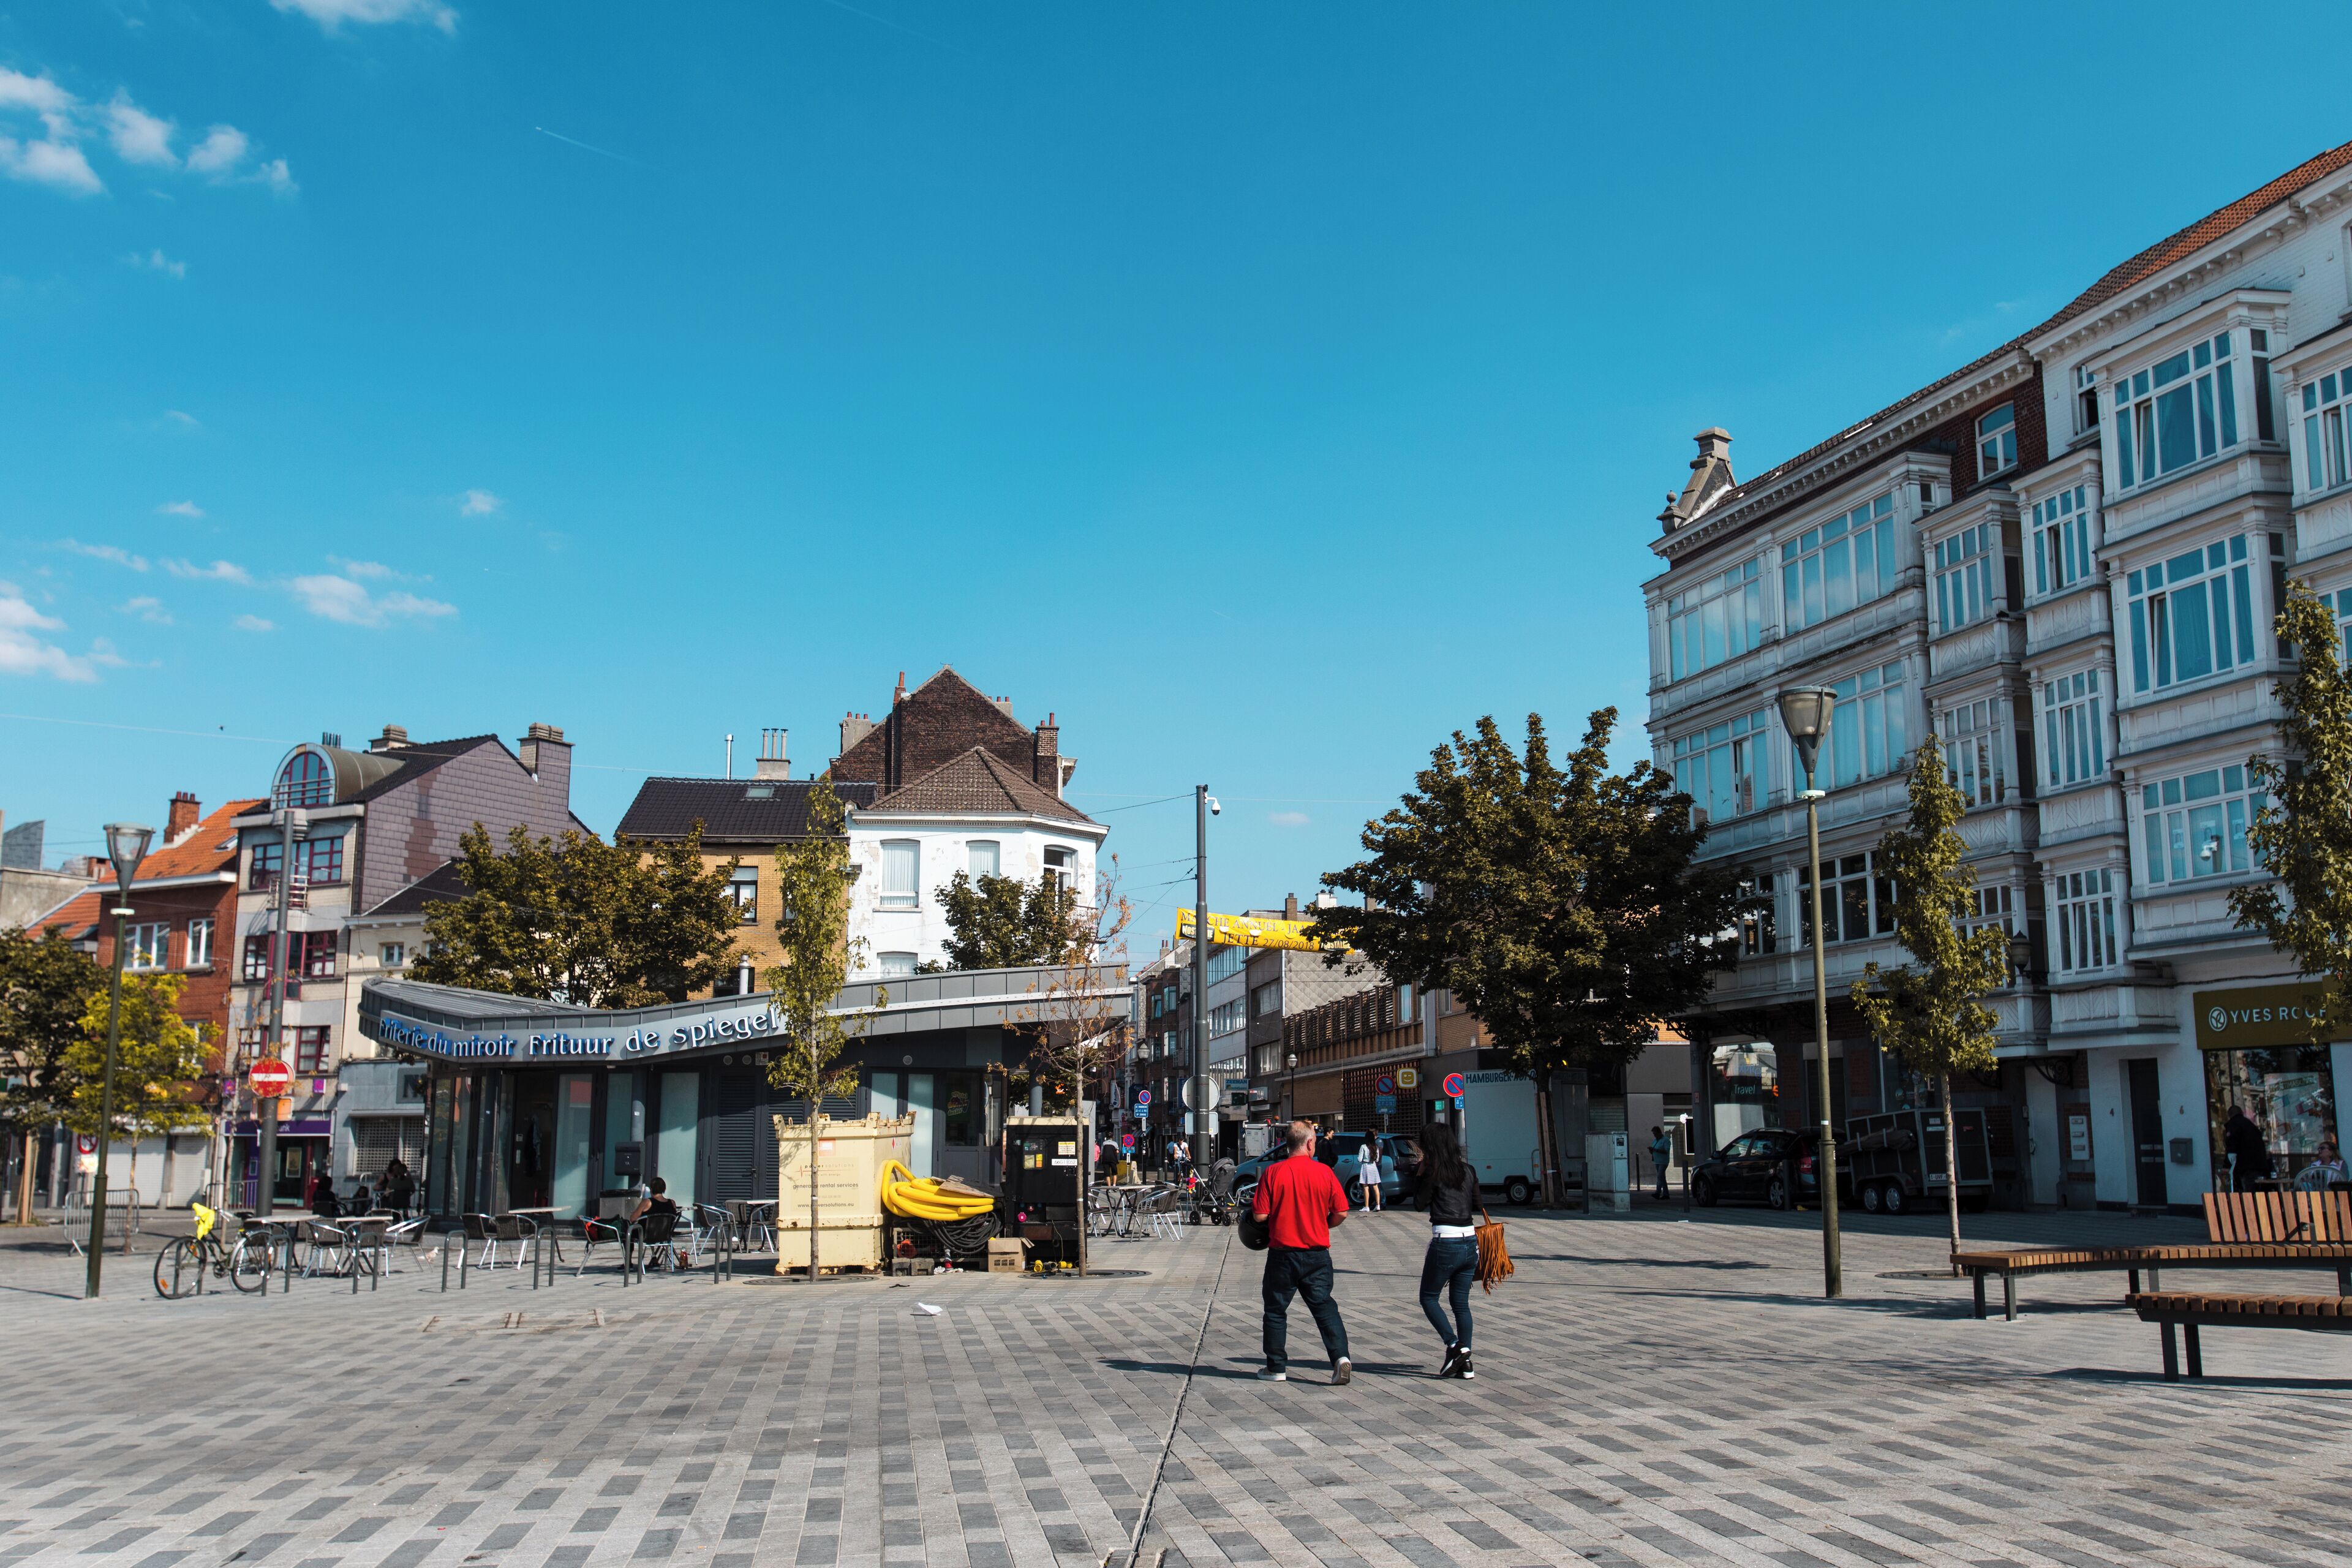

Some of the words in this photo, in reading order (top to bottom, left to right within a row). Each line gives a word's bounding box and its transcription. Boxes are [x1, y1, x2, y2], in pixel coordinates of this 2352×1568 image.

[1181, 912, 1229, 927] MACHE
[1222, 933, 1258, 946] JETTE
[1263, 938, 1314, 949] 27/08/2018
[2230, 1008, 2272, 1023] YVES
[379, 1018, 427, 1049] Friterie
[428, 1032, 450, 1055] du
[453, 1034, 516, 1057] miroir
[529, 1033, 612, 1055] Frituur
[626, 1030, 660, 1052] de
[674, 1007, 777, 1047] spiegel
[1734, 1084, 1755, 1095] Travel
